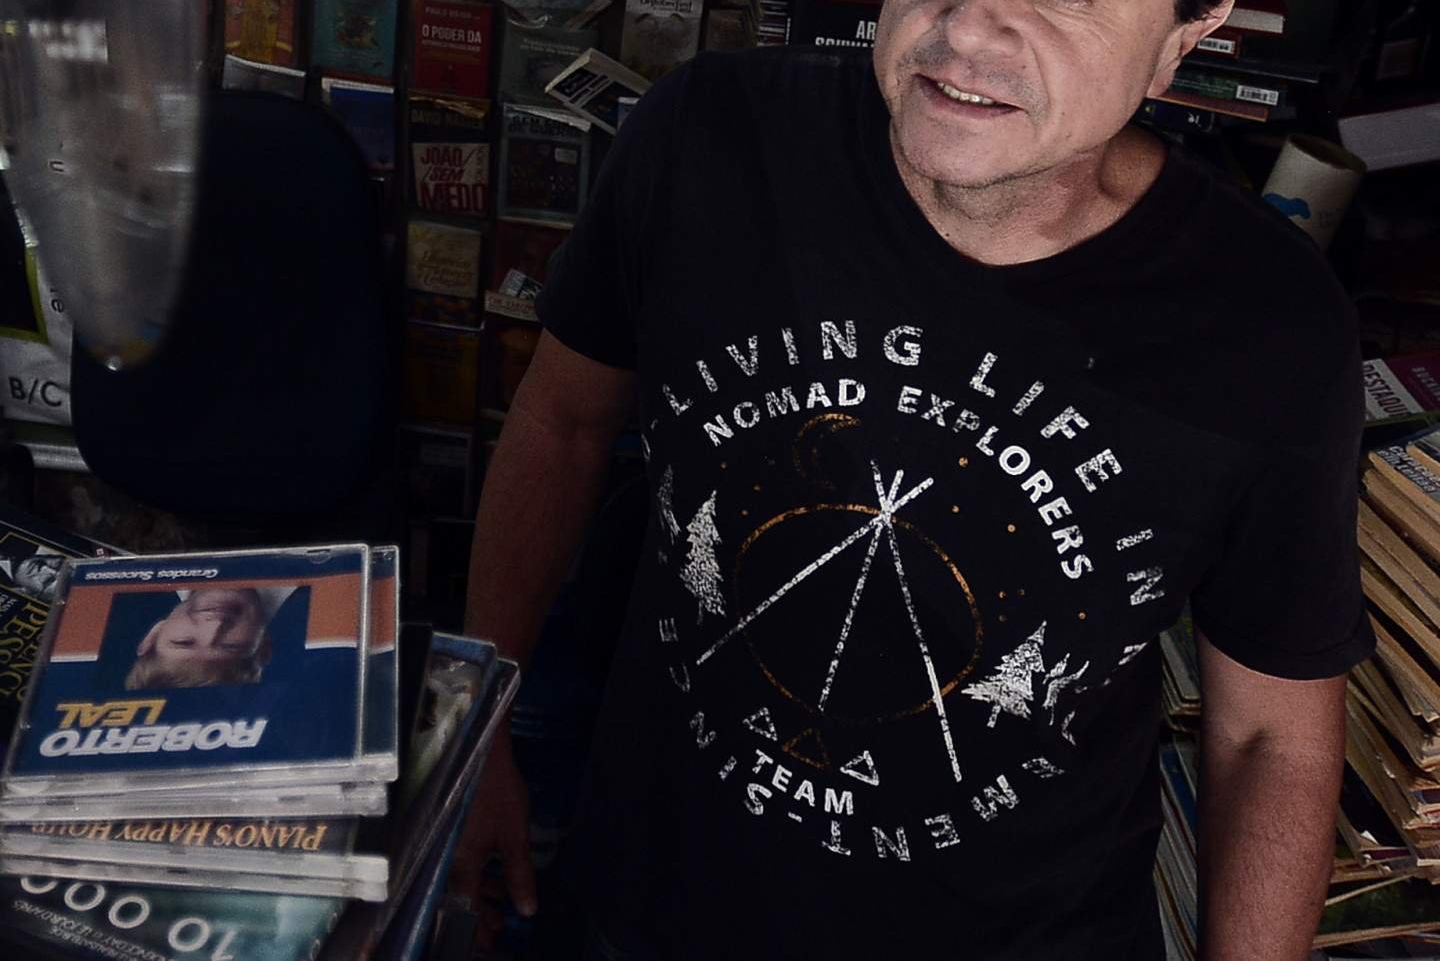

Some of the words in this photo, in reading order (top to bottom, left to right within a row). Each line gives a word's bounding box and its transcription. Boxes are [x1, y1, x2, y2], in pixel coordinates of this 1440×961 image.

[421, 23, 429, 38] O
[431, 24, 465, 41] PODER
[466, 29, 483, 45] DA
[429, 165, 464, 181] SEM
[421, 183, 489, 215] MEDO
[8, 375, 64, 408] B/C
[661, 319, 923, 417] LIVING
[968, 351, 1123, 493] LIFE
[1116, 528, 1165, 606] IN
[703, 377, 866, 447] NOMAD
[897, 384, 1095, 580] EXPLORERS
[156, 568, 220, 580] Grandes
[56, 699, 168, 729] LEAL
[39, 717, 269, 757] ROBERTO
[752, 748, 854, 816] TEAM
[115, 818, 213, 847] HAPPY
[212, 822, 328, 852] PIANO'S
